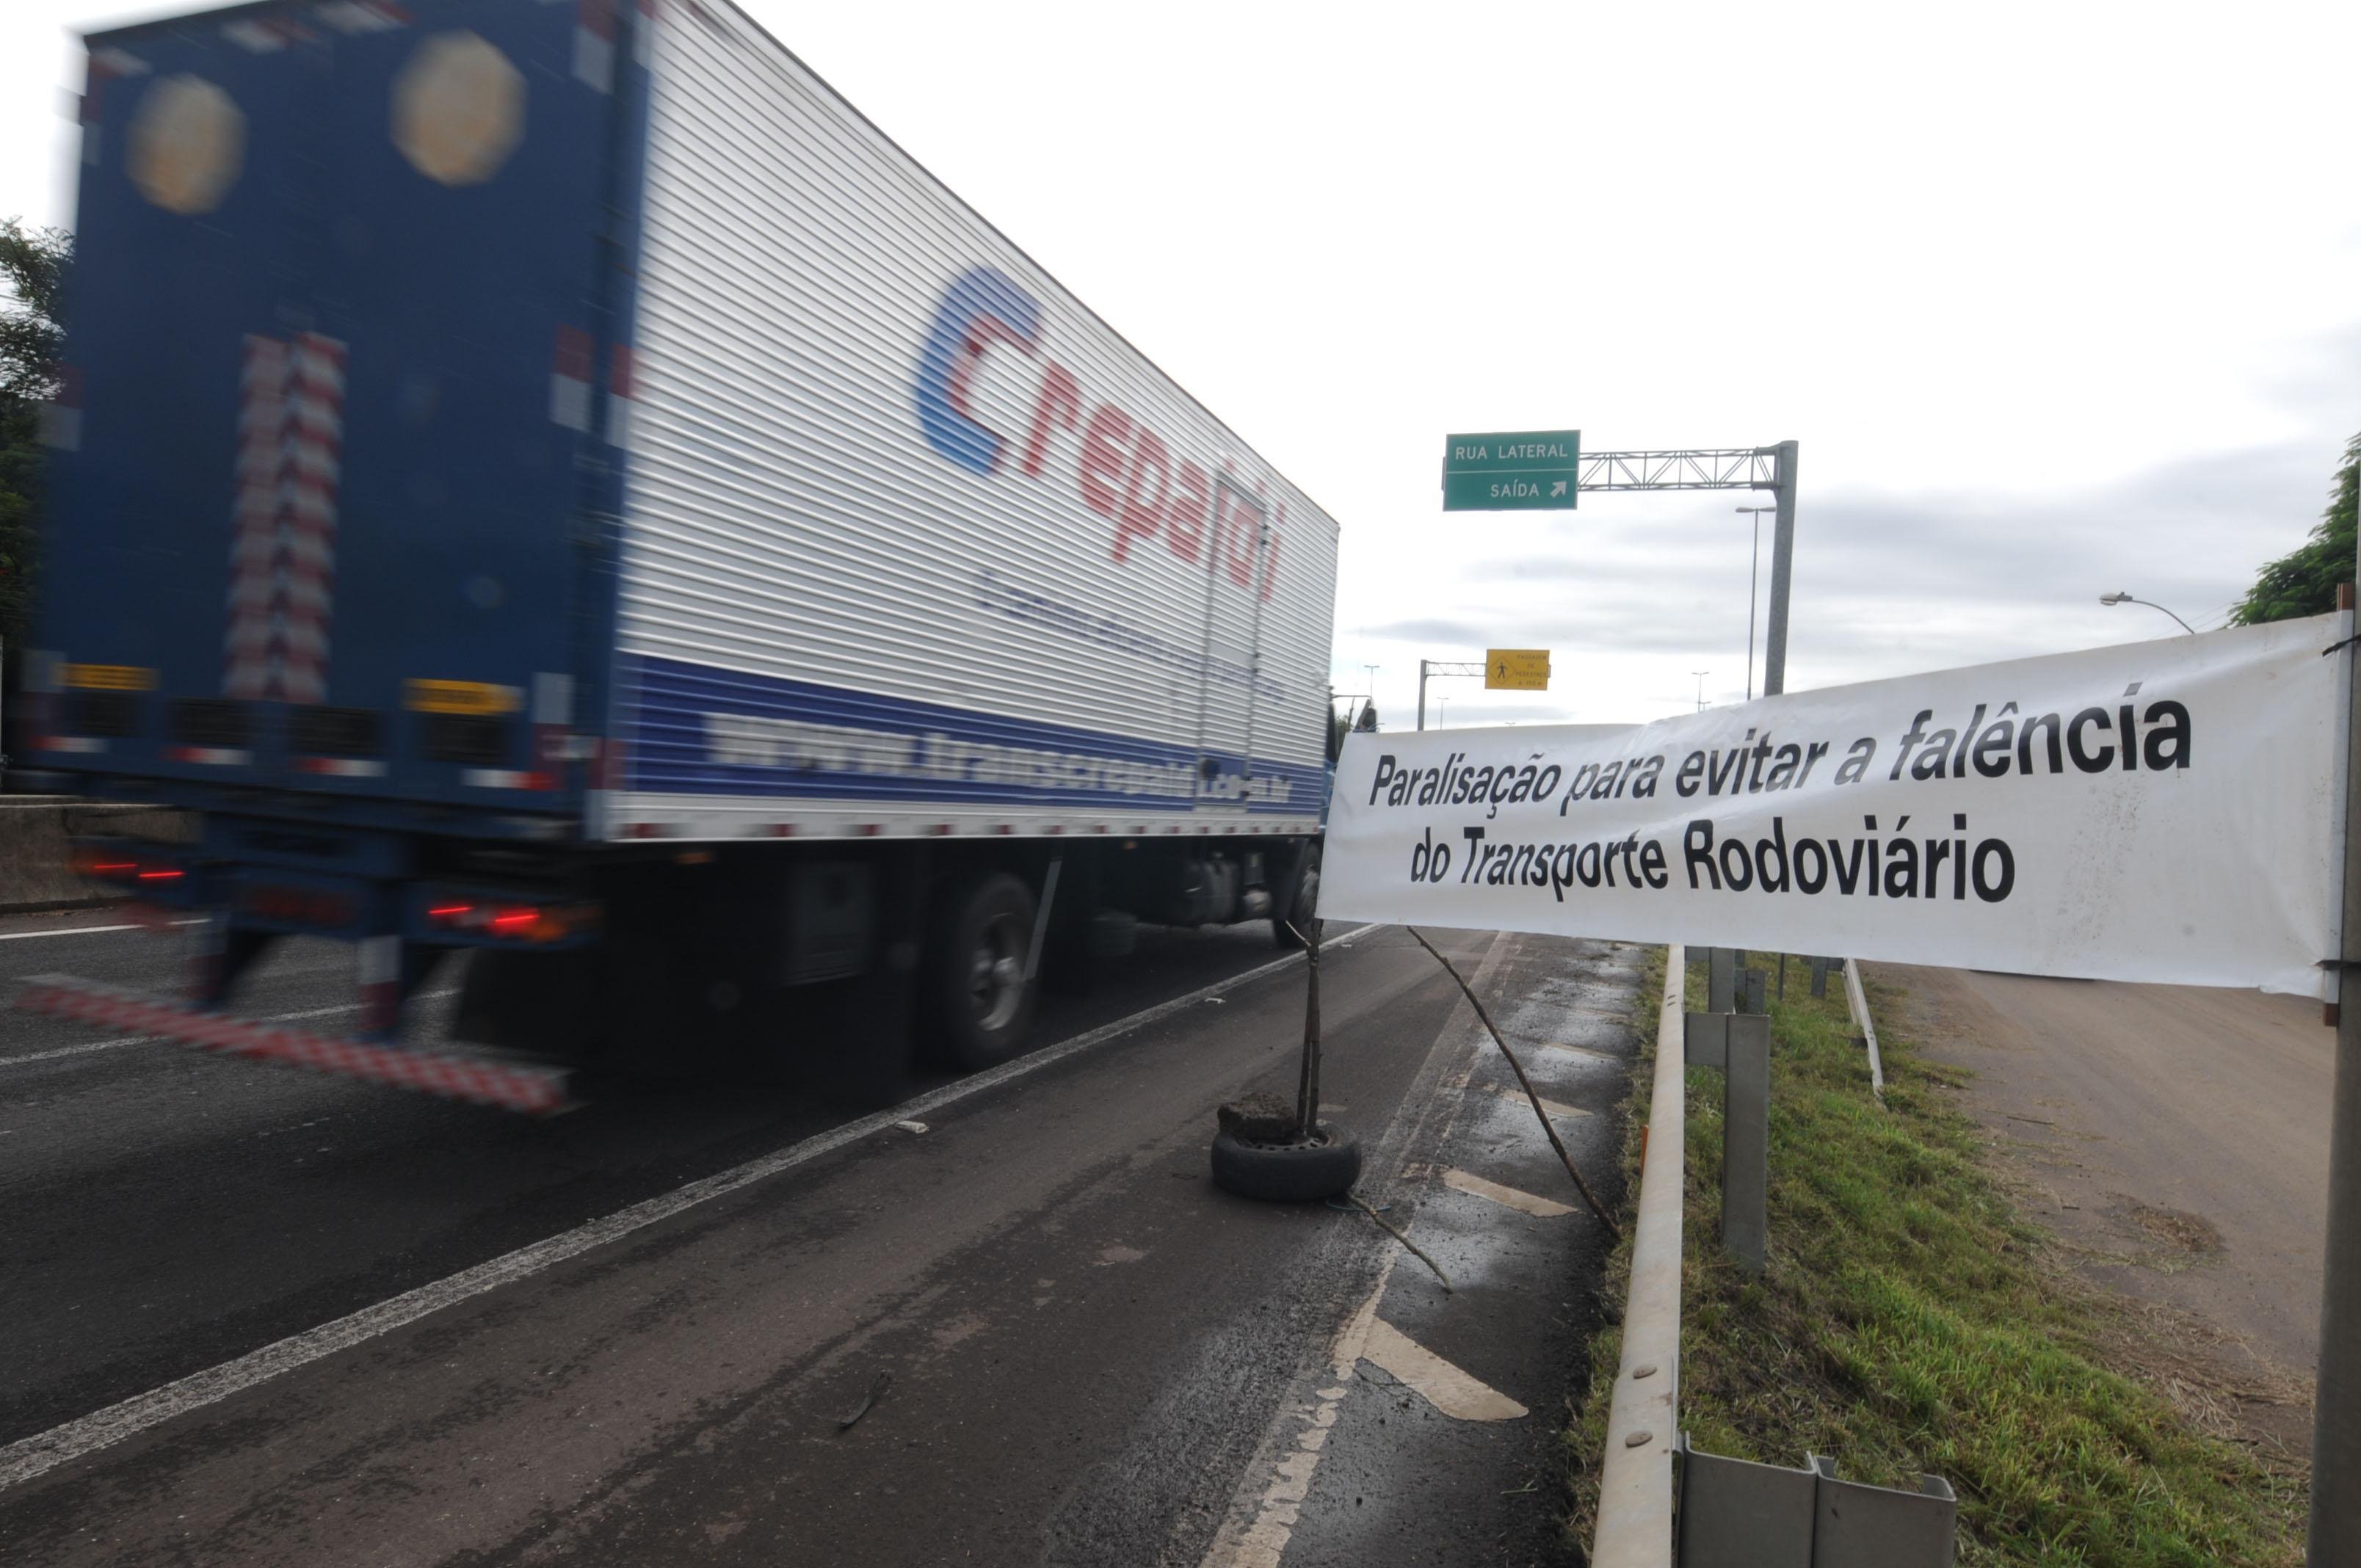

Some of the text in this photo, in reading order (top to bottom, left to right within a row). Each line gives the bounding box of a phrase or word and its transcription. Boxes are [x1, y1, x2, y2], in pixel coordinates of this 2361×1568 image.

[1456, 443, 1567, 460] RUA LATERAL
[1490, 479, 1539, 498] SAÍDA
[1368, 682, 2192, 819] Paralisação para evitar a falência
[1410, 813, 2015, 903] do Transporte Rodoviário
